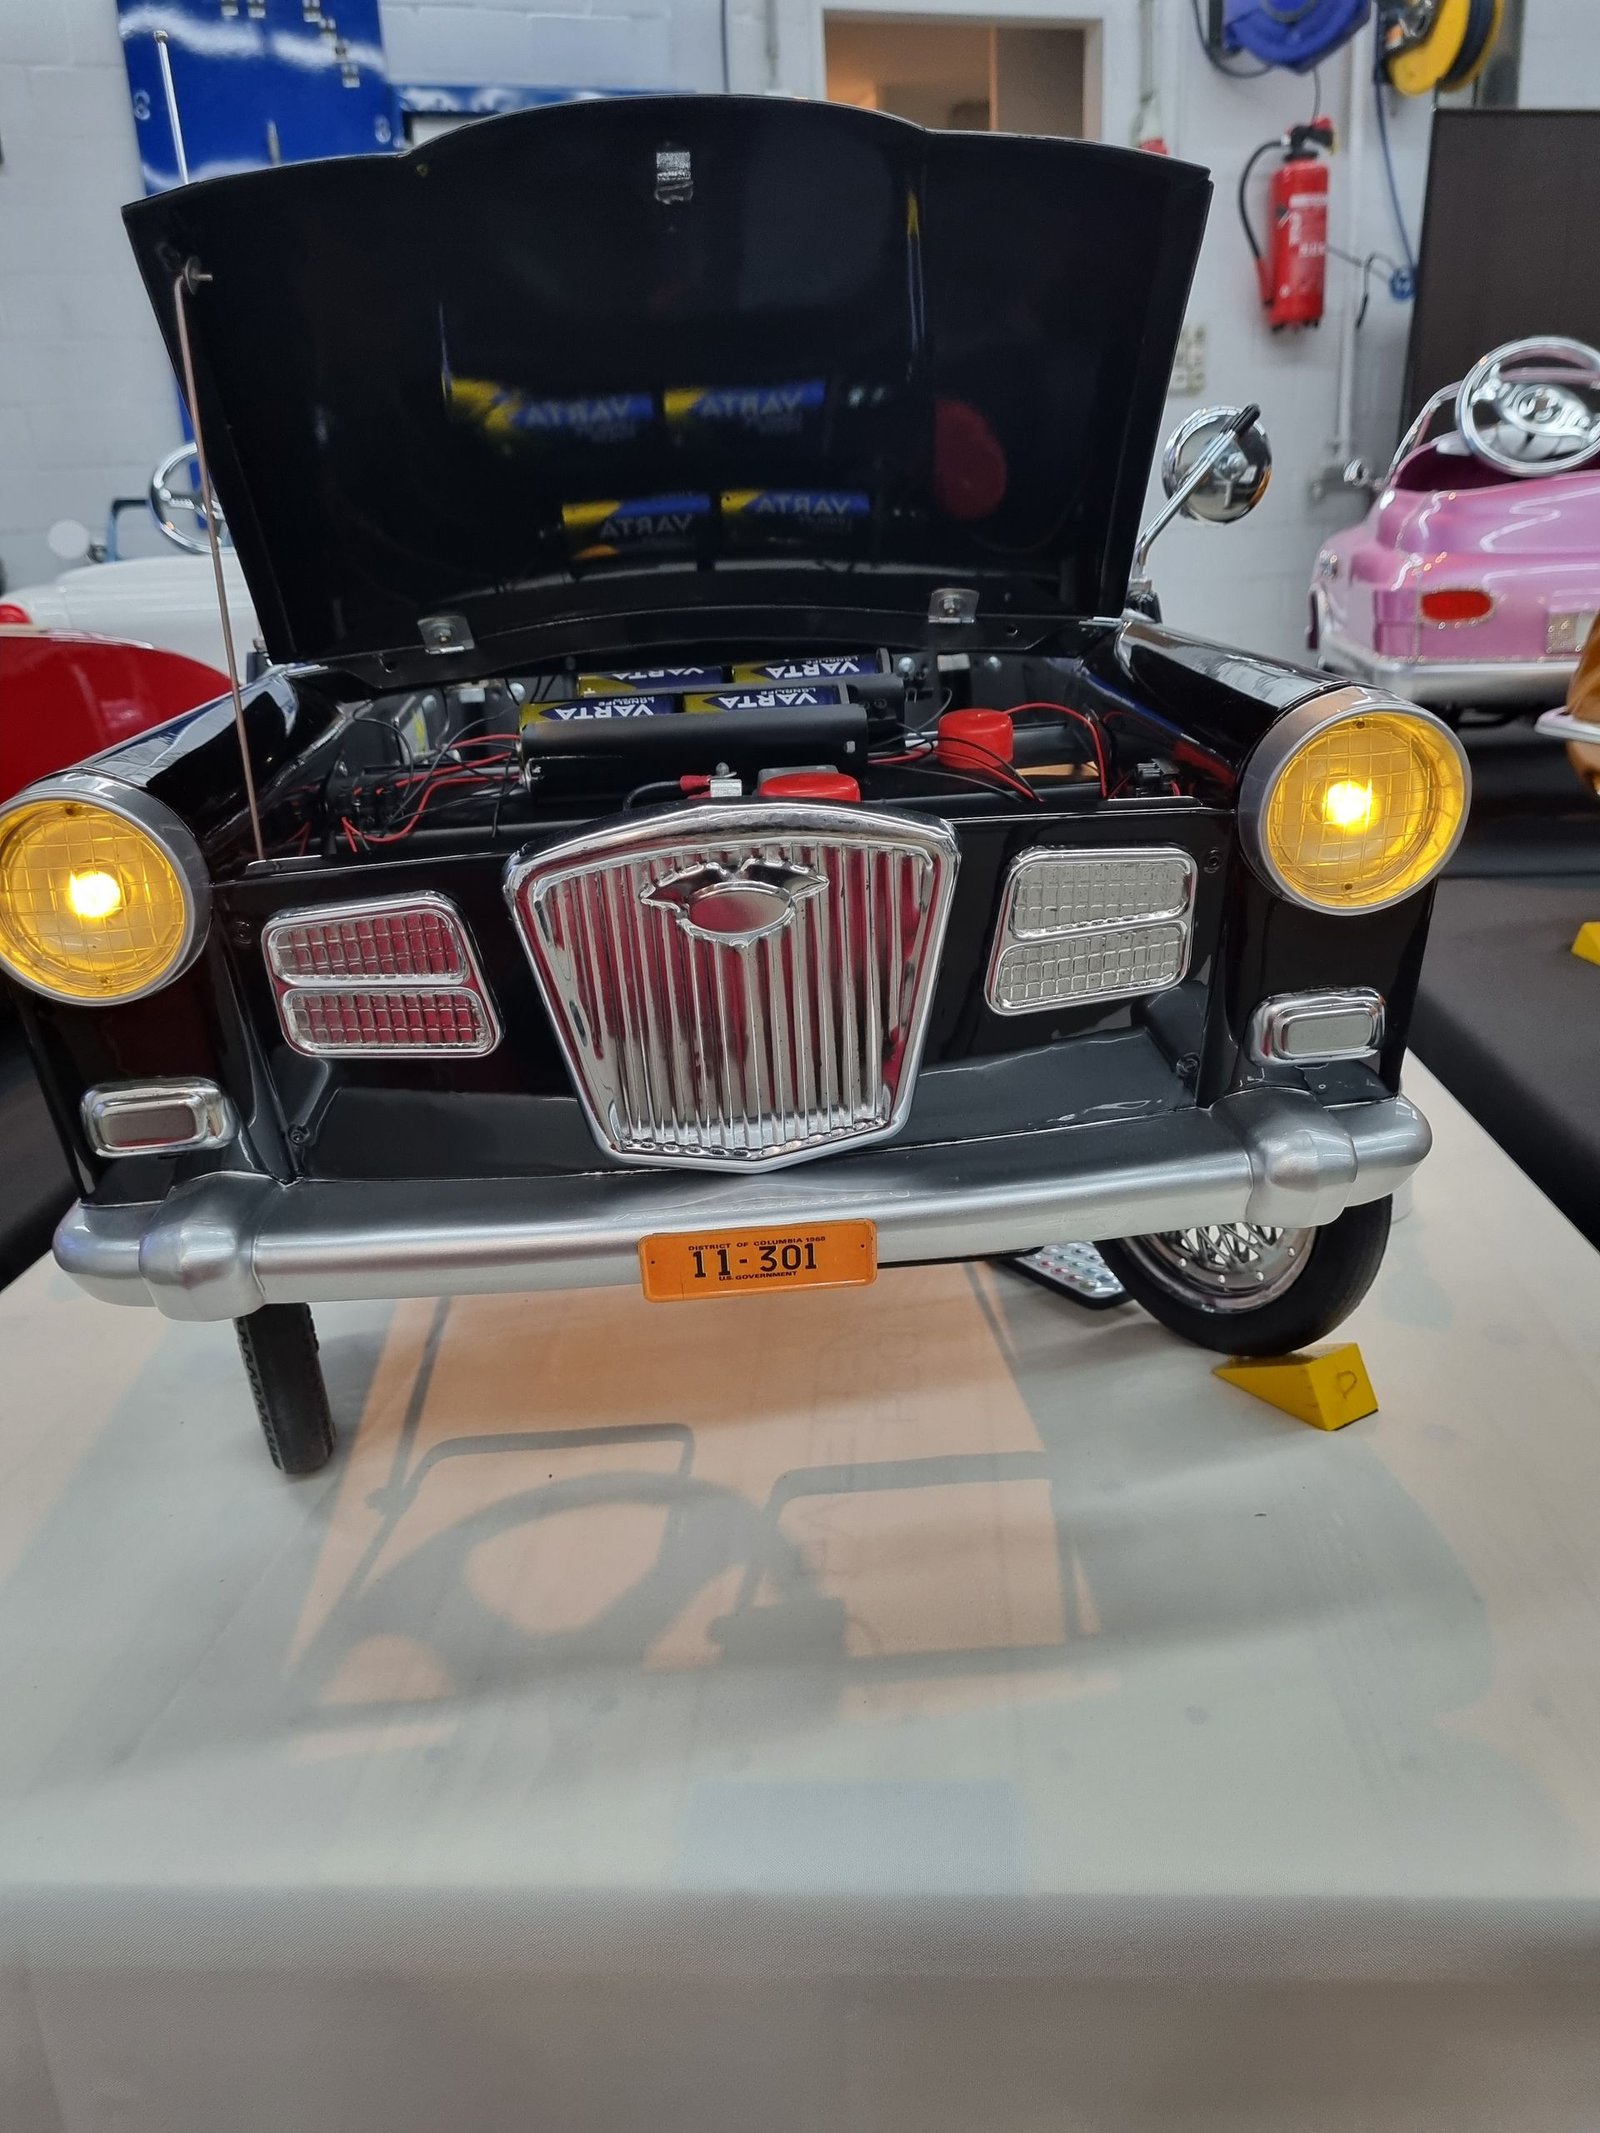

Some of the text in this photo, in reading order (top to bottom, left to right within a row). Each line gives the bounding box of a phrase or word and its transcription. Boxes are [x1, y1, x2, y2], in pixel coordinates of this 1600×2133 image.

[612, 667, 704, 680] VARTA
[765, 661, 860, 679] VARTA
[718, 693, 818, 709] VARTA
[554, 704, 654, 720] VARTA
[753, 1238, 803, 1246] COLUMBIA
[693, 1243, 817, 1278] 11-301
[735, 1271, 797, 1280] GOVERNMENT
